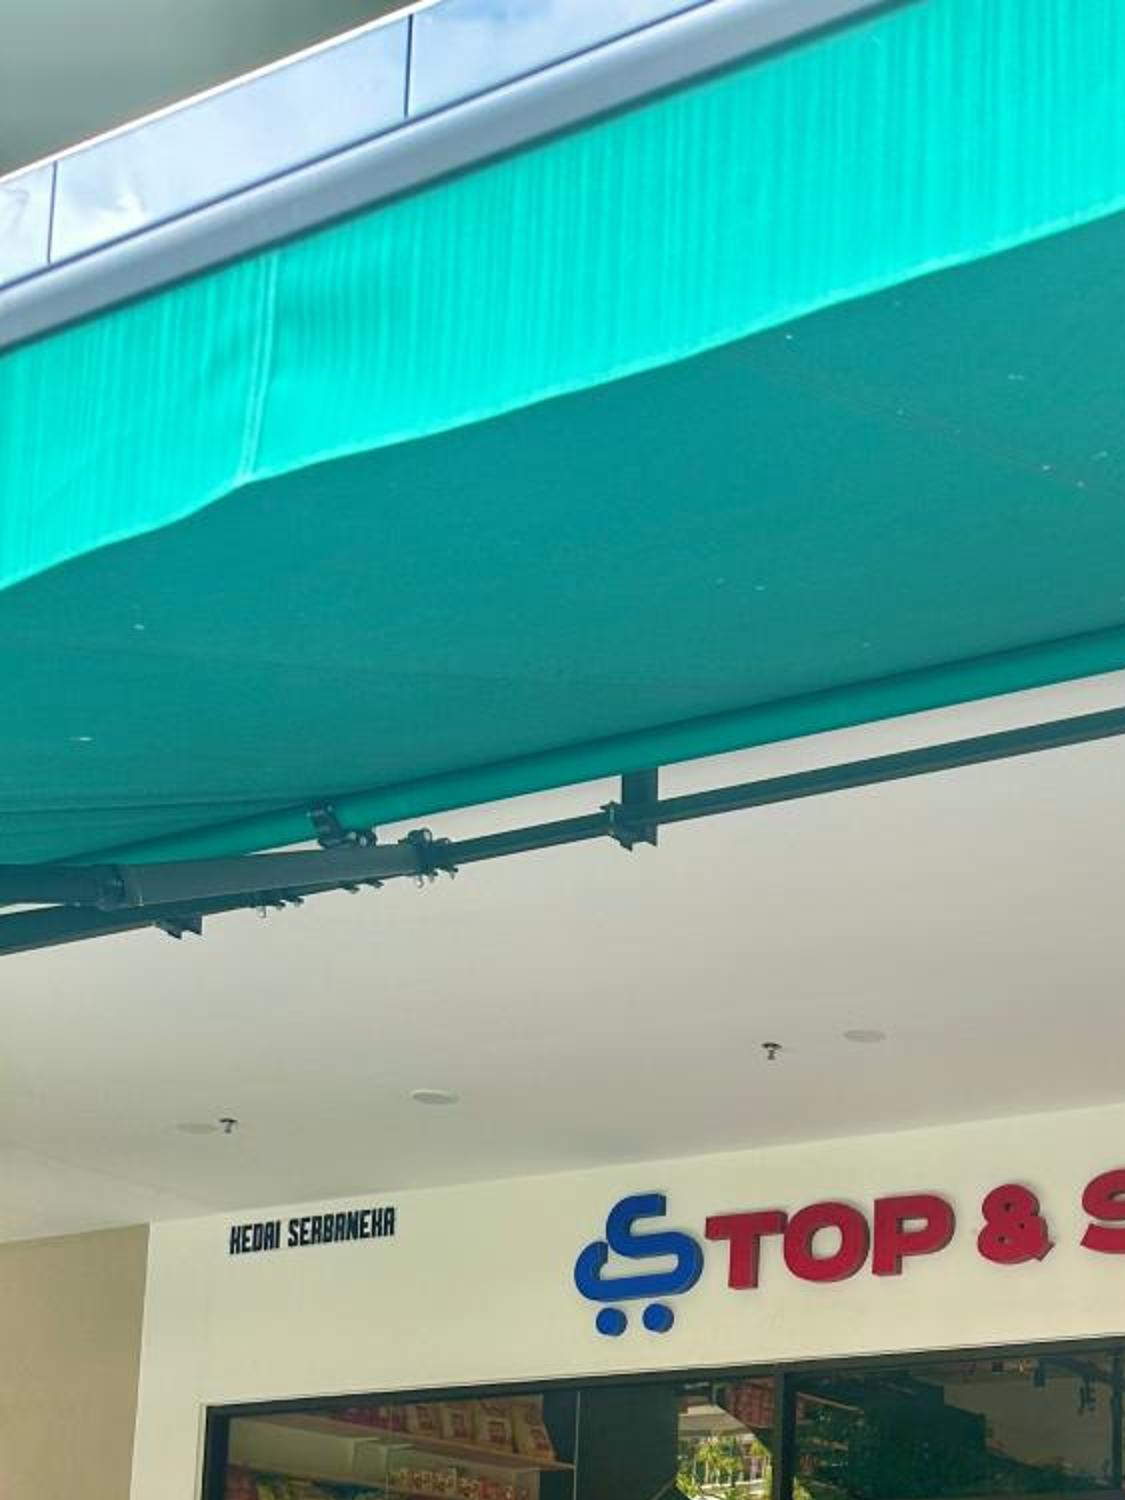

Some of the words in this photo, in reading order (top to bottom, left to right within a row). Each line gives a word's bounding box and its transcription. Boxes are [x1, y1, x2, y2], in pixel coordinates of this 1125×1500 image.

[229, 1220, 281, 1255] KEDAI
[287, 1207, 396, 1247] SERBANEKA
[574, 1193, 956, 1335] STOP
[977, 1184, 1054, 1265] &
